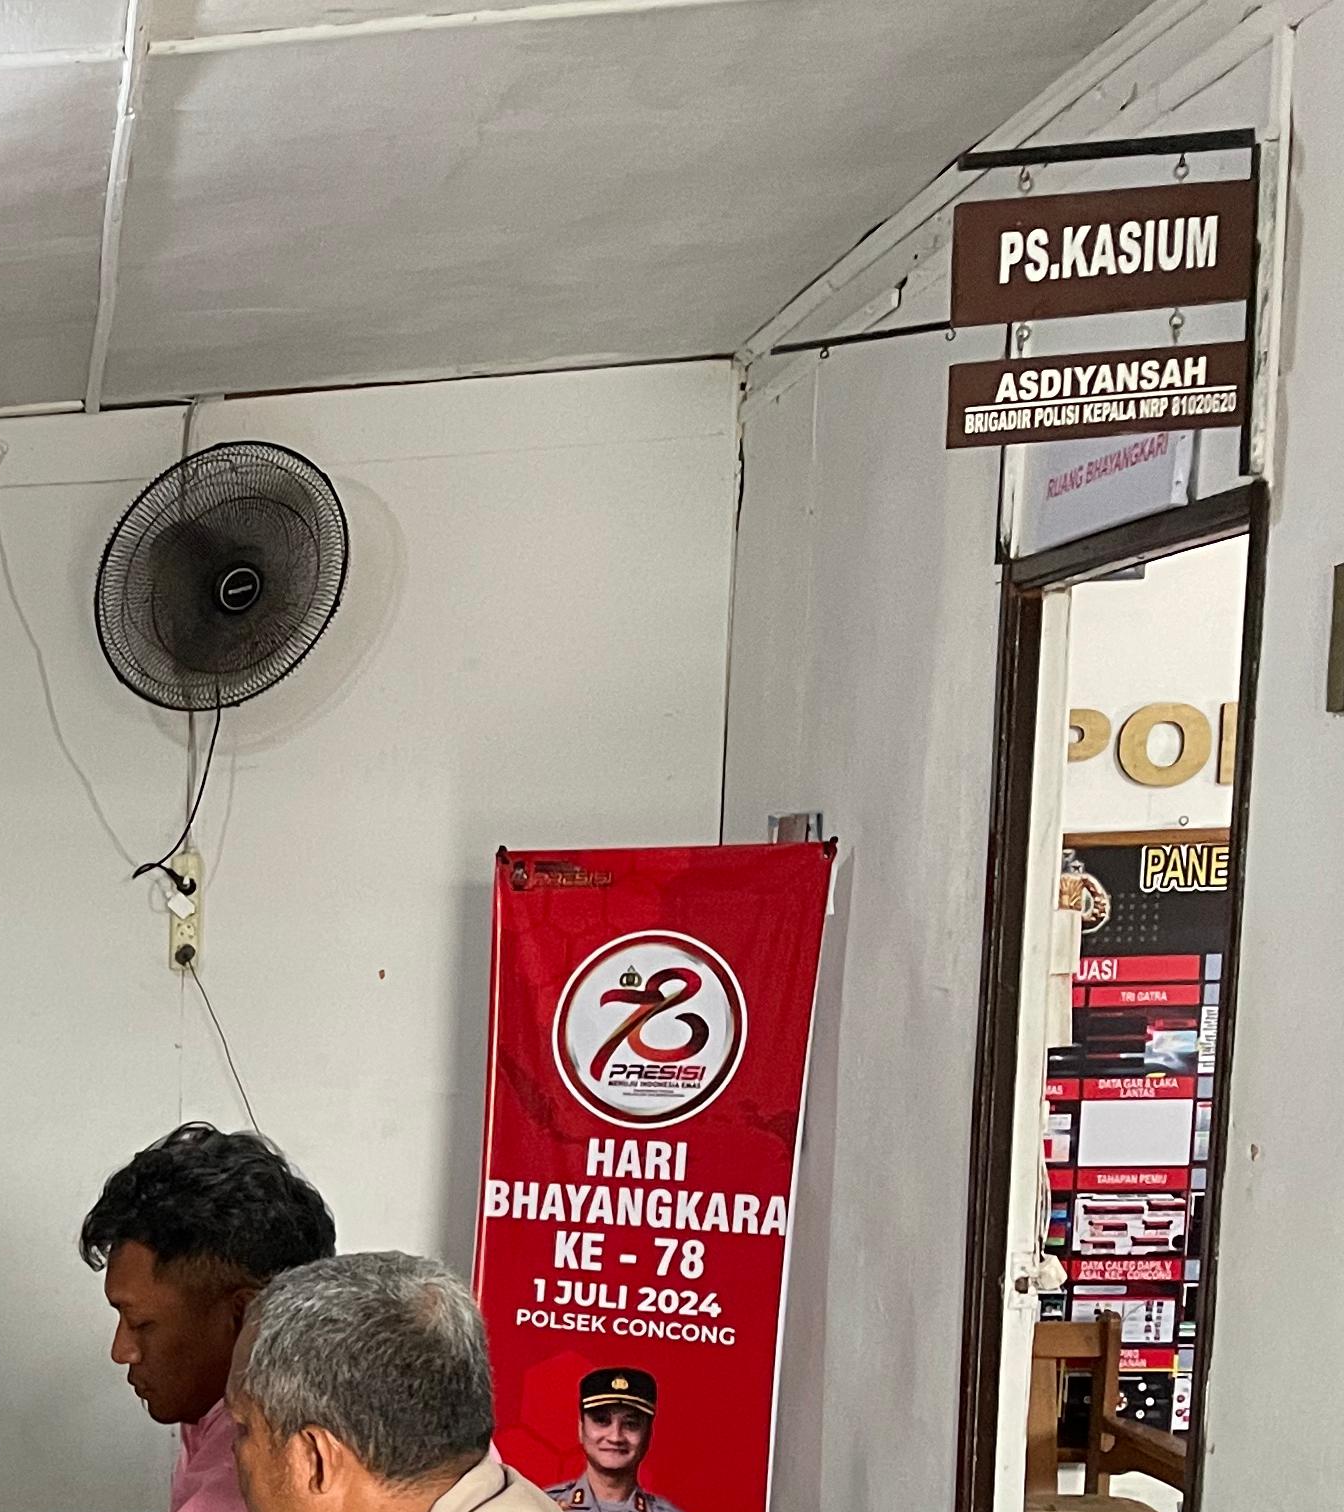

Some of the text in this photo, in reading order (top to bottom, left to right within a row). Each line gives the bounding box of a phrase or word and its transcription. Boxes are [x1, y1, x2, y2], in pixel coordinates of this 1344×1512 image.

[998, 215, 1219, 284] PS.KASIUM
[995, 356, 1207, 403] ASDIYANSAH
[964, 391, 1237, 434] BRIGADIR POLISI KEPALA NRP 81020620
[1046, 431, 1169, 501] RUANG BHAYANGKARI
[1144, 846, 1230, 888] PANE
[609, 1063, 707, 1081] PRESISI
[586, 1137, 688, 1181] HARI
[485, 1178, 788, 1236] BHAYANGKARA
[553, 1230, 605, 1271] KE
[653, 1237, 706, 1280] 78
[1080, 1261, 1104, 1270] DATA
[533, 1278, 723, 1319] 1 JULI 2024
[515, 1308, 737, 1347] POLSEK CONCONG
